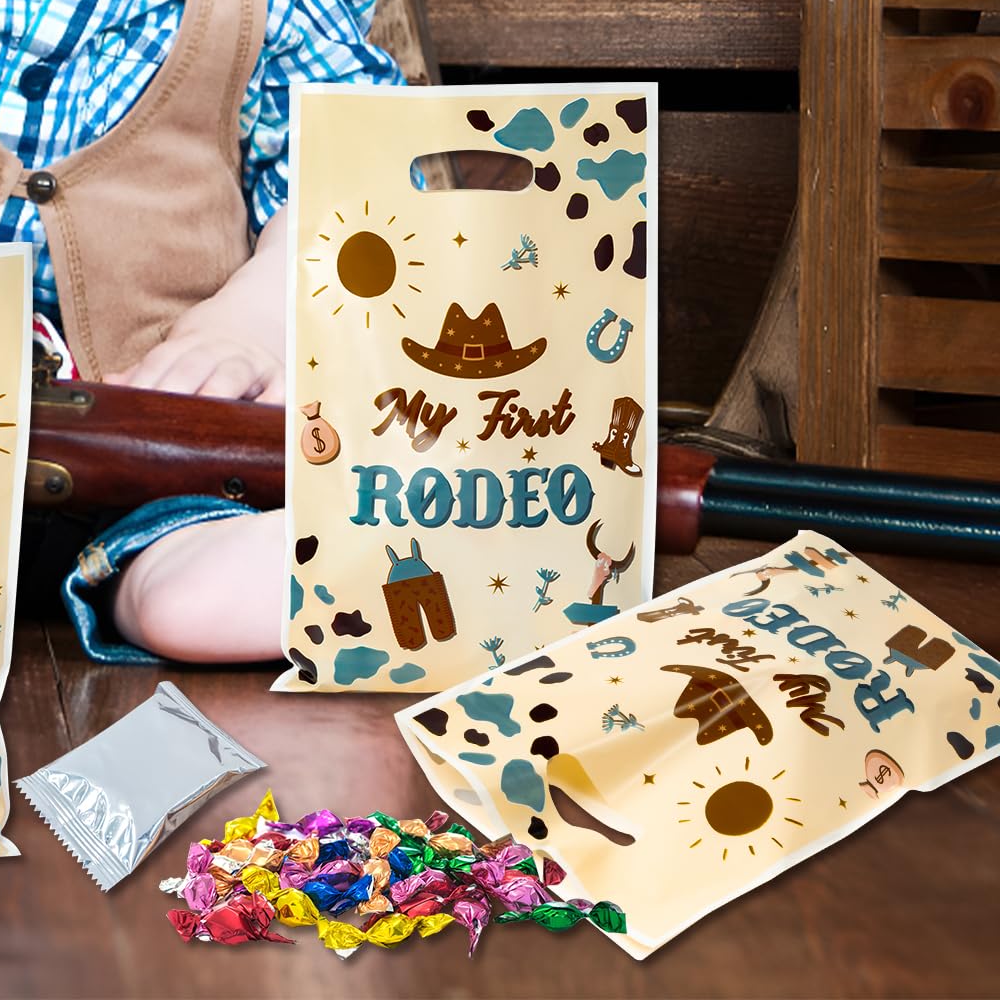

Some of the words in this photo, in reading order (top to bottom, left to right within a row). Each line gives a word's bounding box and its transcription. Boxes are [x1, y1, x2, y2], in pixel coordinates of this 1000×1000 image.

[372, 387, 457, 453] My
[476, 387, 576, 441] First
[349, 463, 596, 530] RODEO
[677, 628, 776, 672] First
[722, 598, 915, 733] RODEO
[773, 673, 846, 736] My
